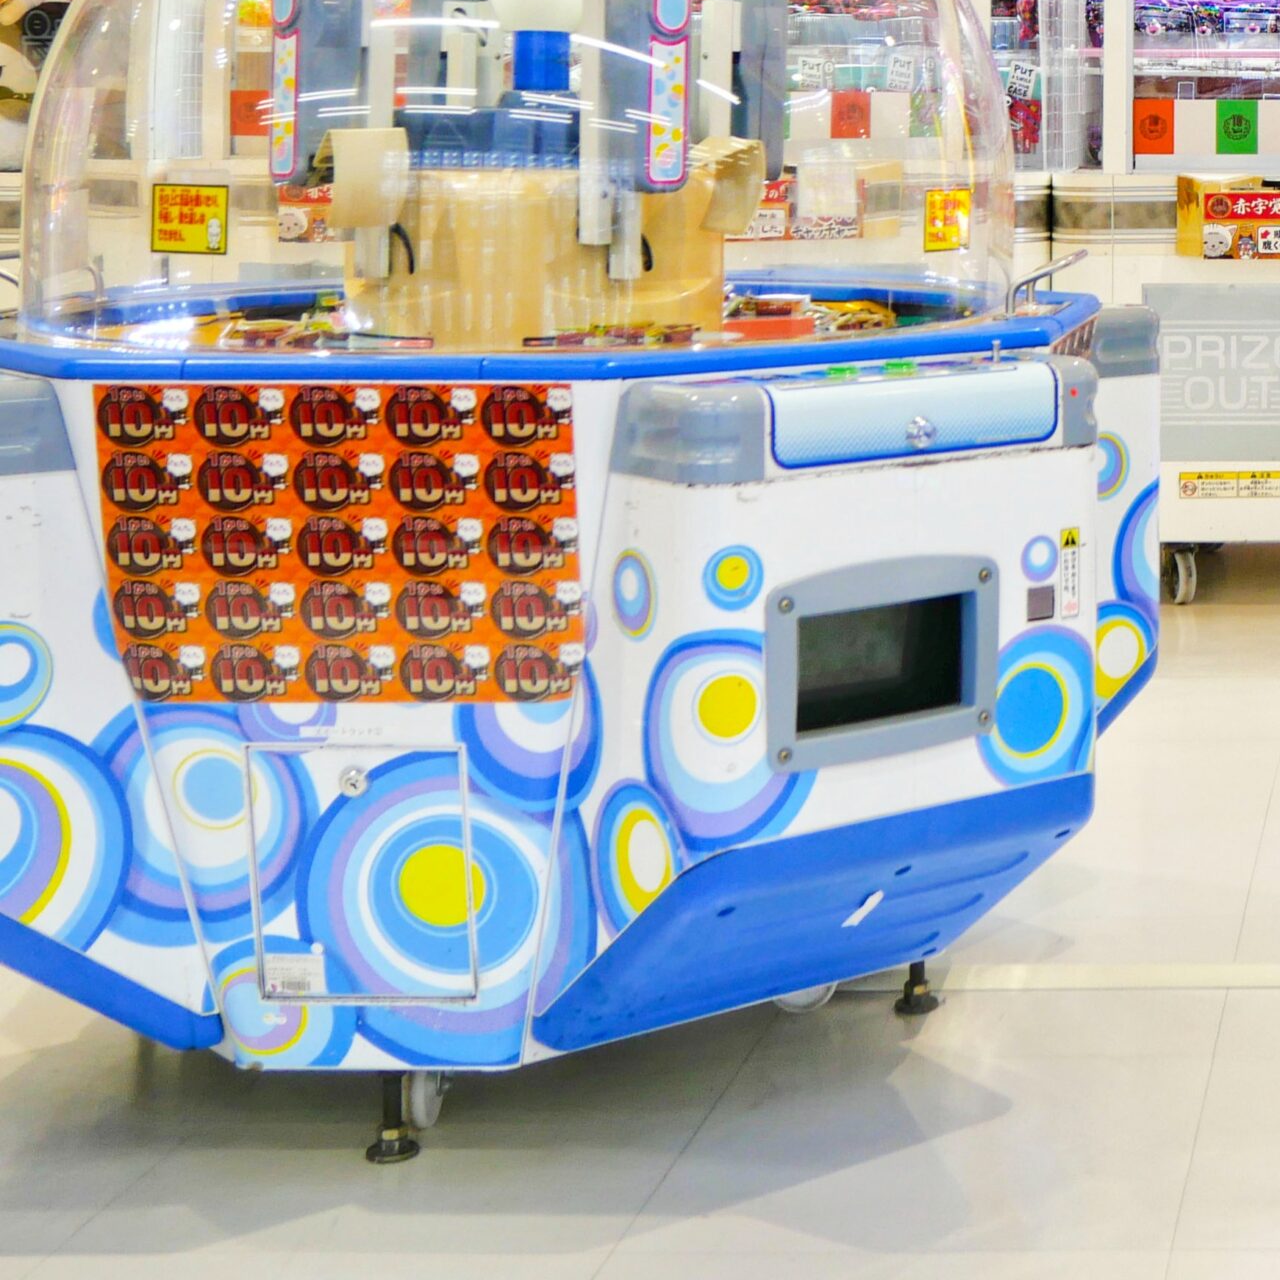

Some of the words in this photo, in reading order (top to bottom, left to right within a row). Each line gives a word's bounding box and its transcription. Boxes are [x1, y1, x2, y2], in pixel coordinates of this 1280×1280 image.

[1014, 64, 1034, 77] PUT
[1007, 85, 1028, 97] CASE
[1184, 375, 1280, 410] OUT
[107, 402, 173, 439] 10円
[203, 402, 269, 439] 10円
[299, 402, 365, 439] 10円
[395, 402, 461, 439] 10円
[491, 402, 557, 439] 10円
[111, 467, 177, 504] 10円
[207, 467, 273, 504] 10円
[303, 467, 369, 504] 10円
[398, 467, 464, 504] 10円
[493, 467, 559, 504] 10円
[117, 532, 180, 568] 10円
[210, 532, 276, 569] 10円
[306, 531, 372, 568] 10円
[401, 532, 467, 569] 10円
[496, 532, 562, 569] 10円
[122, 596, 185, 632] 10円
[216, 596, 279, 632] 10円
[311, 596, 374, 632] 10円
[405, 595, 471, 632] 10円
[500, 595, 566, 632] 10円
[129, 660, 190, 694] 10円
[221, 659, 284, 695] 10円
[315, 659, 378, 695] 10円
[410, 659, 473, 695] 10円
[505, 658, 568, 694] 10円
